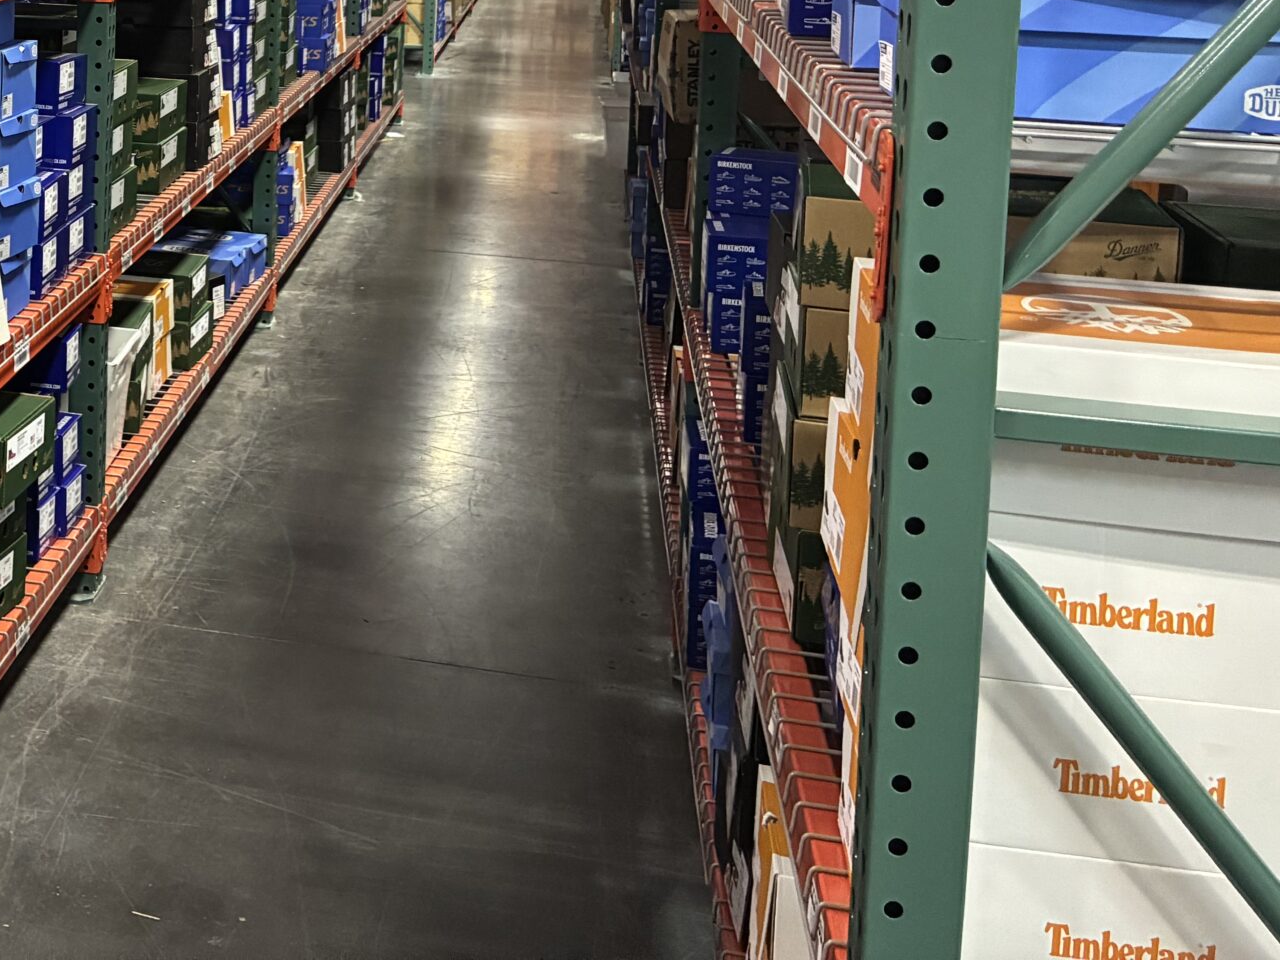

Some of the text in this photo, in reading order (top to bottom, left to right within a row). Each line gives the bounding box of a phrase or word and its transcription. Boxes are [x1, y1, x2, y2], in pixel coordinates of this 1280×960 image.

[687, 41, 700, 107] STANLEY
[1104, 239, 1161, 261] Danner
[1053, 757, 1226, 810] Timberd
